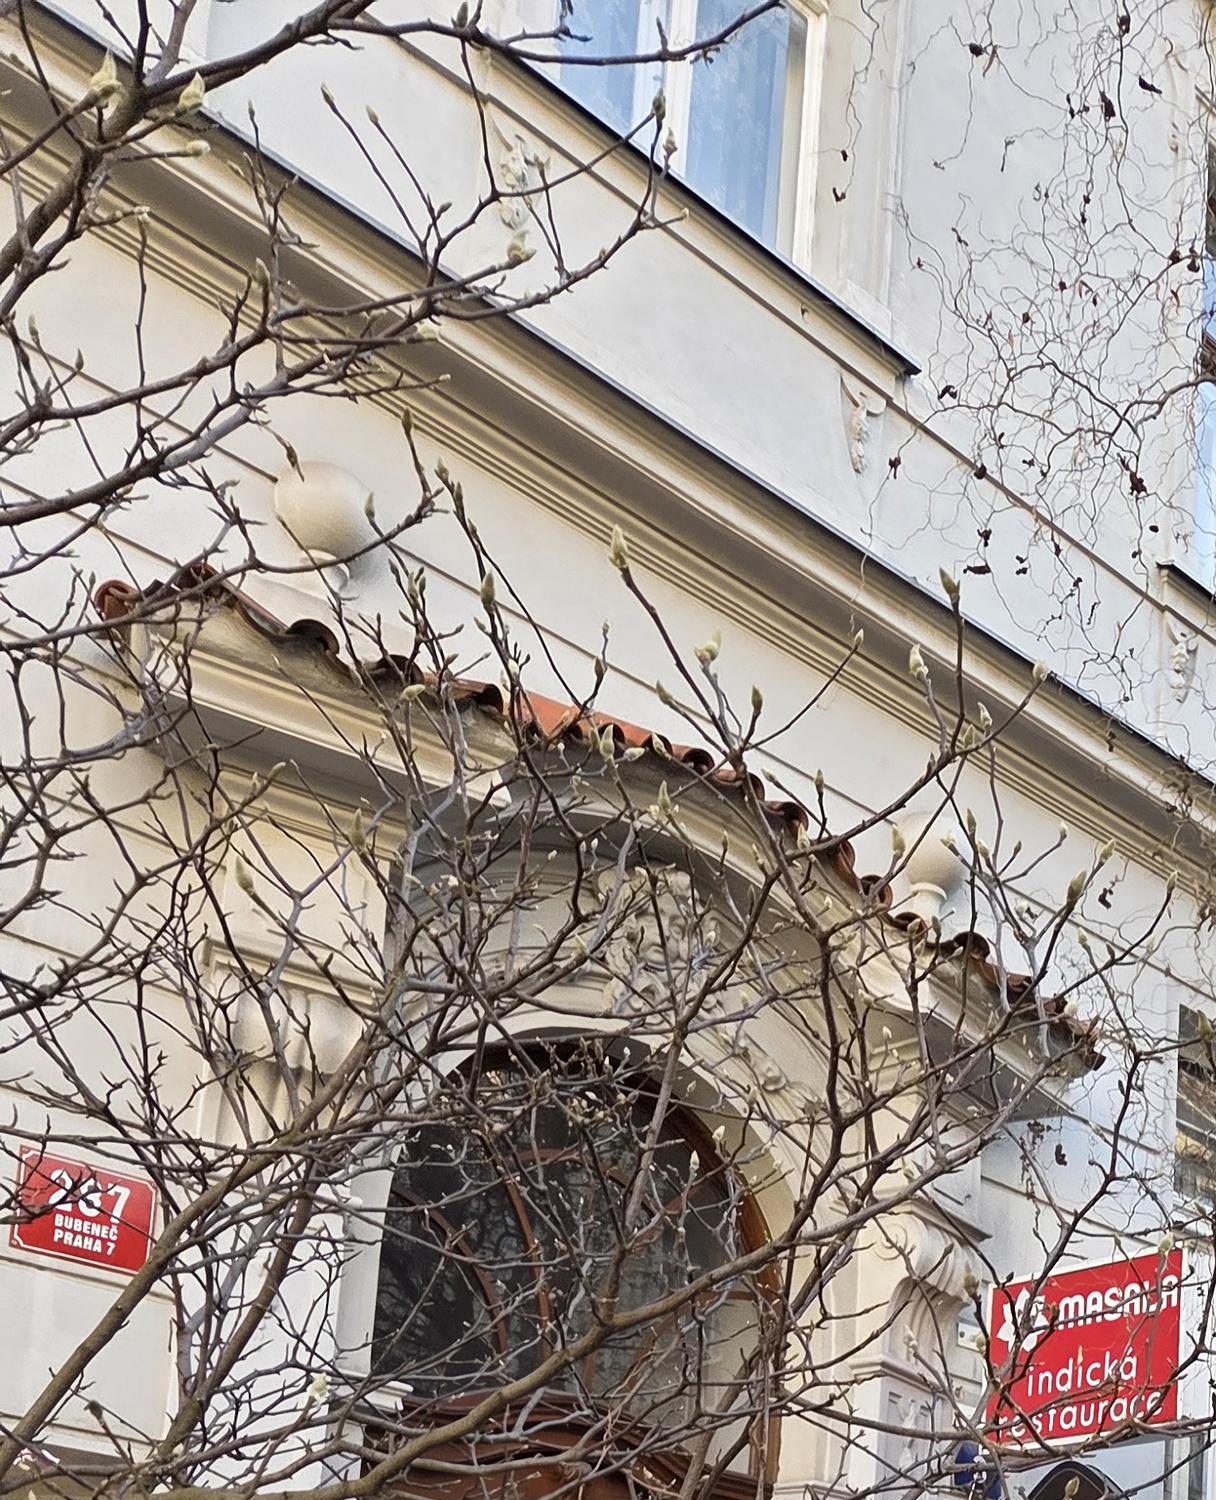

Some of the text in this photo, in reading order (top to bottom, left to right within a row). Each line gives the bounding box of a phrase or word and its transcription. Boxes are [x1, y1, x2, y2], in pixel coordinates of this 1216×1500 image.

[53, 1229, 116, 1256] PRAHA 7
[54, 1213, 119, 1241] BUBENEČ
[1058, 1274, 1179, 1331] MASALA
[1027, 1346, 1138, 1397] indická
[999, 1391, 1163, 1439] restaurace
